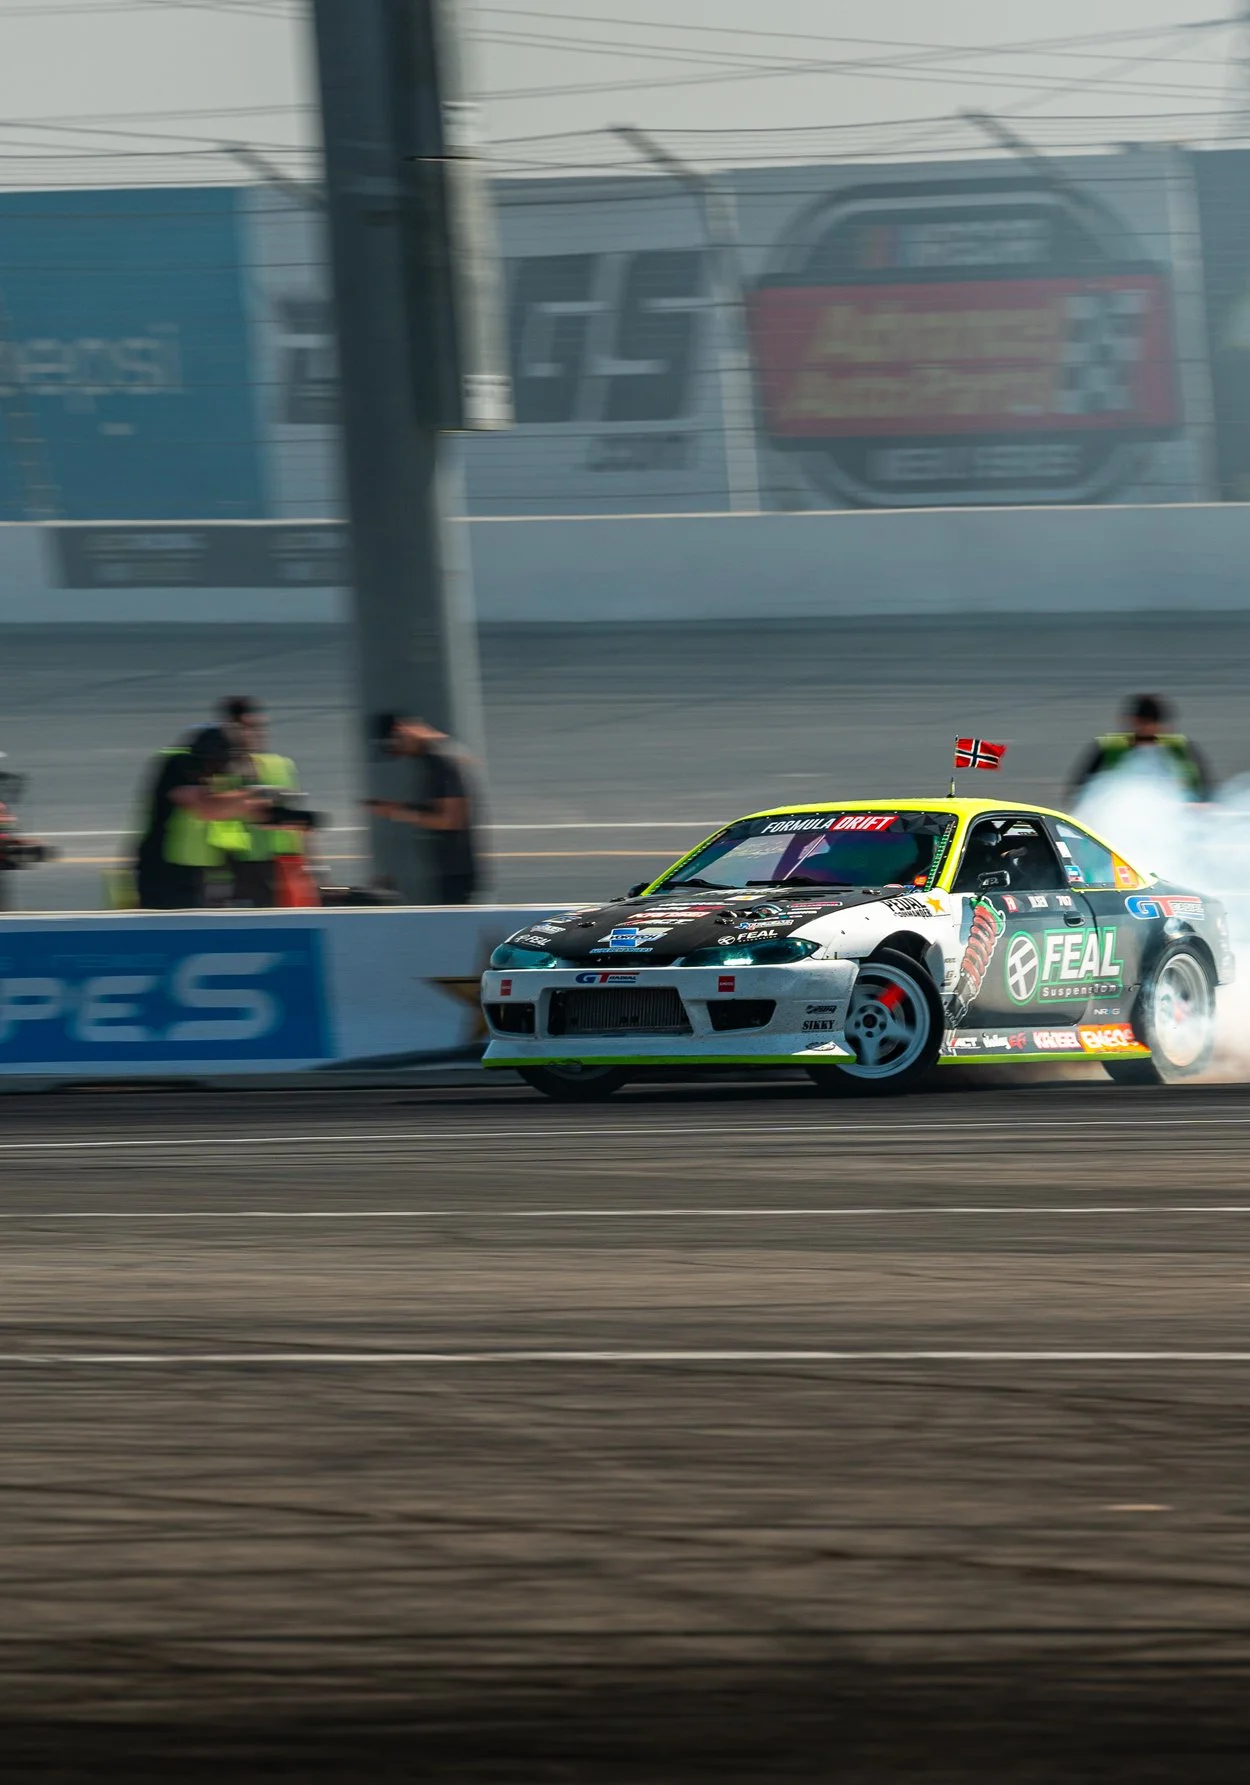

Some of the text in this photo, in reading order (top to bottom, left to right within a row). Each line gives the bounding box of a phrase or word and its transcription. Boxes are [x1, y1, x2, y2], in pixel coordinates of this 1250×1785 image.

[760, 816, 894, 834] FORMULA DRIFT
[881, 896, 926, 912] PEDAL
[737, 929, 779, 942] FEAL
[1041, 932, 1121, 981] FEAL
[1041, 983, 1118, 998] Suspension
[801, 1019, 836, 1031] SIKKY
